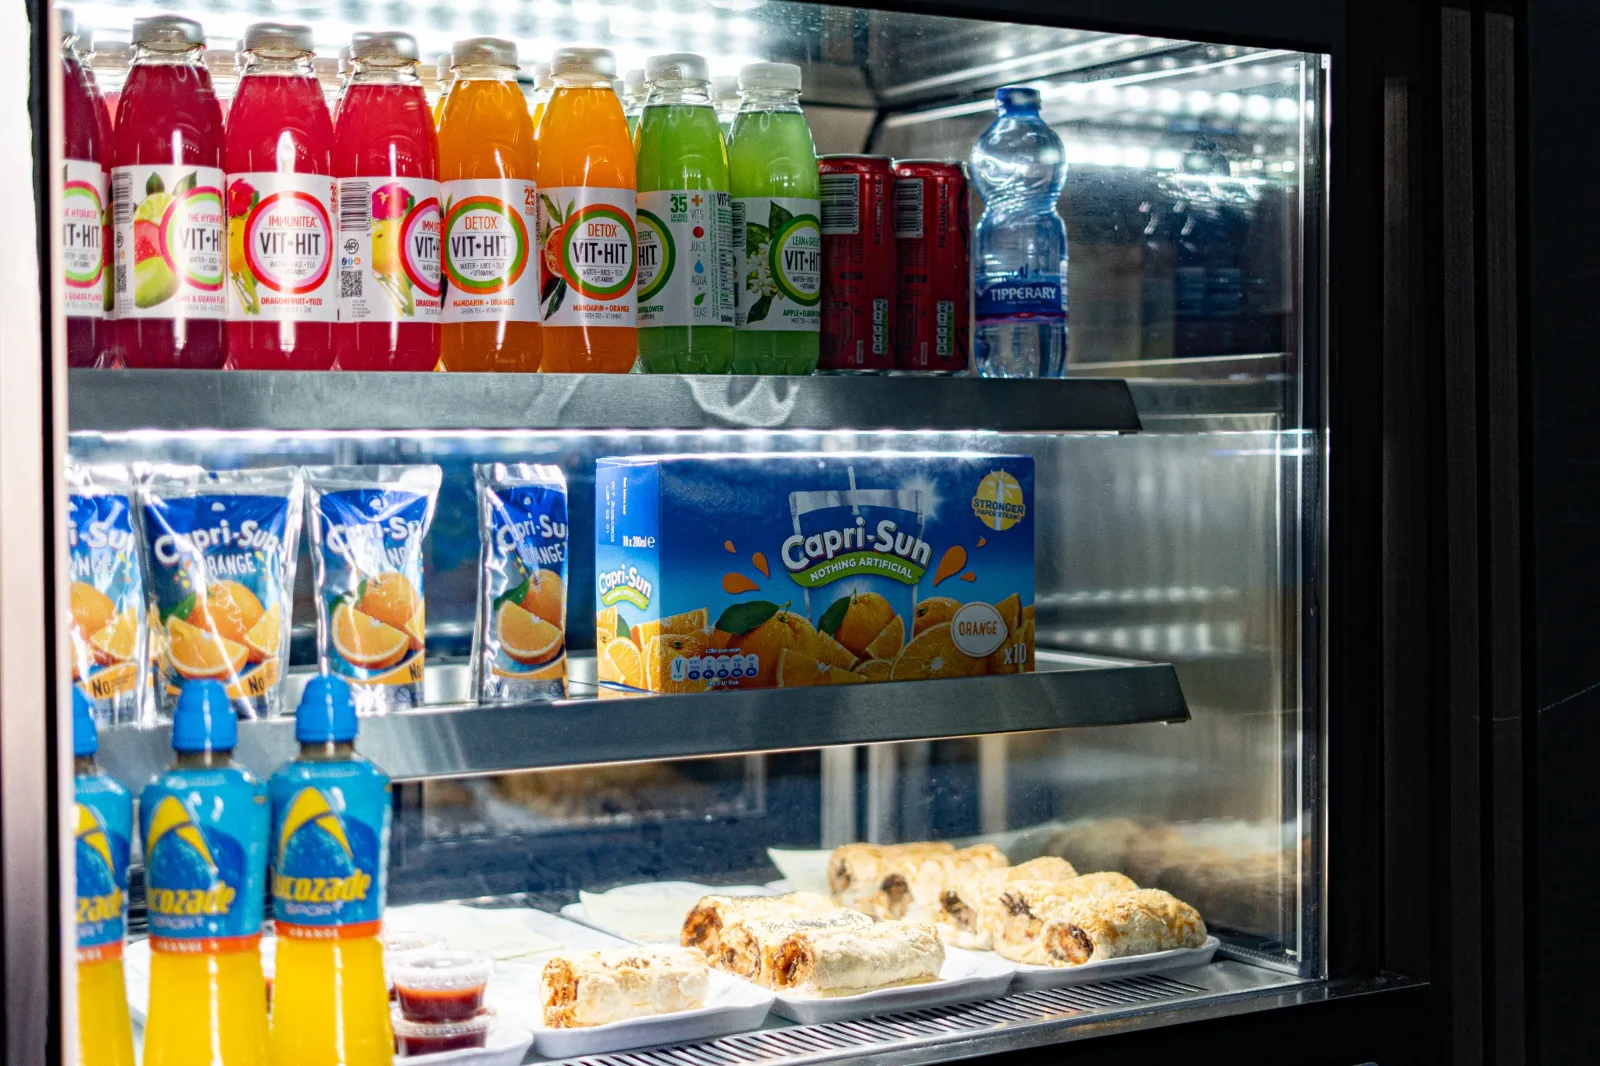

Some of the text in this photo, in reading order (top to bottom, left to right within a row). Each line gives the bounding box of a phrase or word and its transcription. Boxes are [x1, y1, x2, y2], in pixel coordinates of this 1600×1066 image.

[524, 187, 535, 206] 25
[671, 196, 688, 213] 35
[187, 213, 199, 222] THE
[268, 216, 317, 227] IMMUNITEA
[691, 209, 704, 219] VITS
[464, 215, 498, 230] DETOX
[588, 223, 617, 237] DETOX
[690, 242, 706, 251] JUICE
[691, 275, 707, 285] AQUA
[990, 286, 1057, 301] TIPPERARY
[453, 300, 484, 308] MANDARIN
[609, 304, 630, 312] ORANGE
[693, 307, 706, 317] TEAS
[973, 498, 1024, 514] STRONGER
[976, 508, 996, 516] PAPER
[154, 518, 283, 567] Cpri-Sun
[781, 516, 933, 573] Capri-Sun
[203, 552, 257, 577] RANGE
[810, 557, 913, 582] NOTHING ARTIFICIAL
[598, 563, 652, 600] Capri-Sun
[958, 620, 998, 636] ORANGE
[1004, 643, 1027, 665] x10
[287, 927, 339, 939] ORANGE
